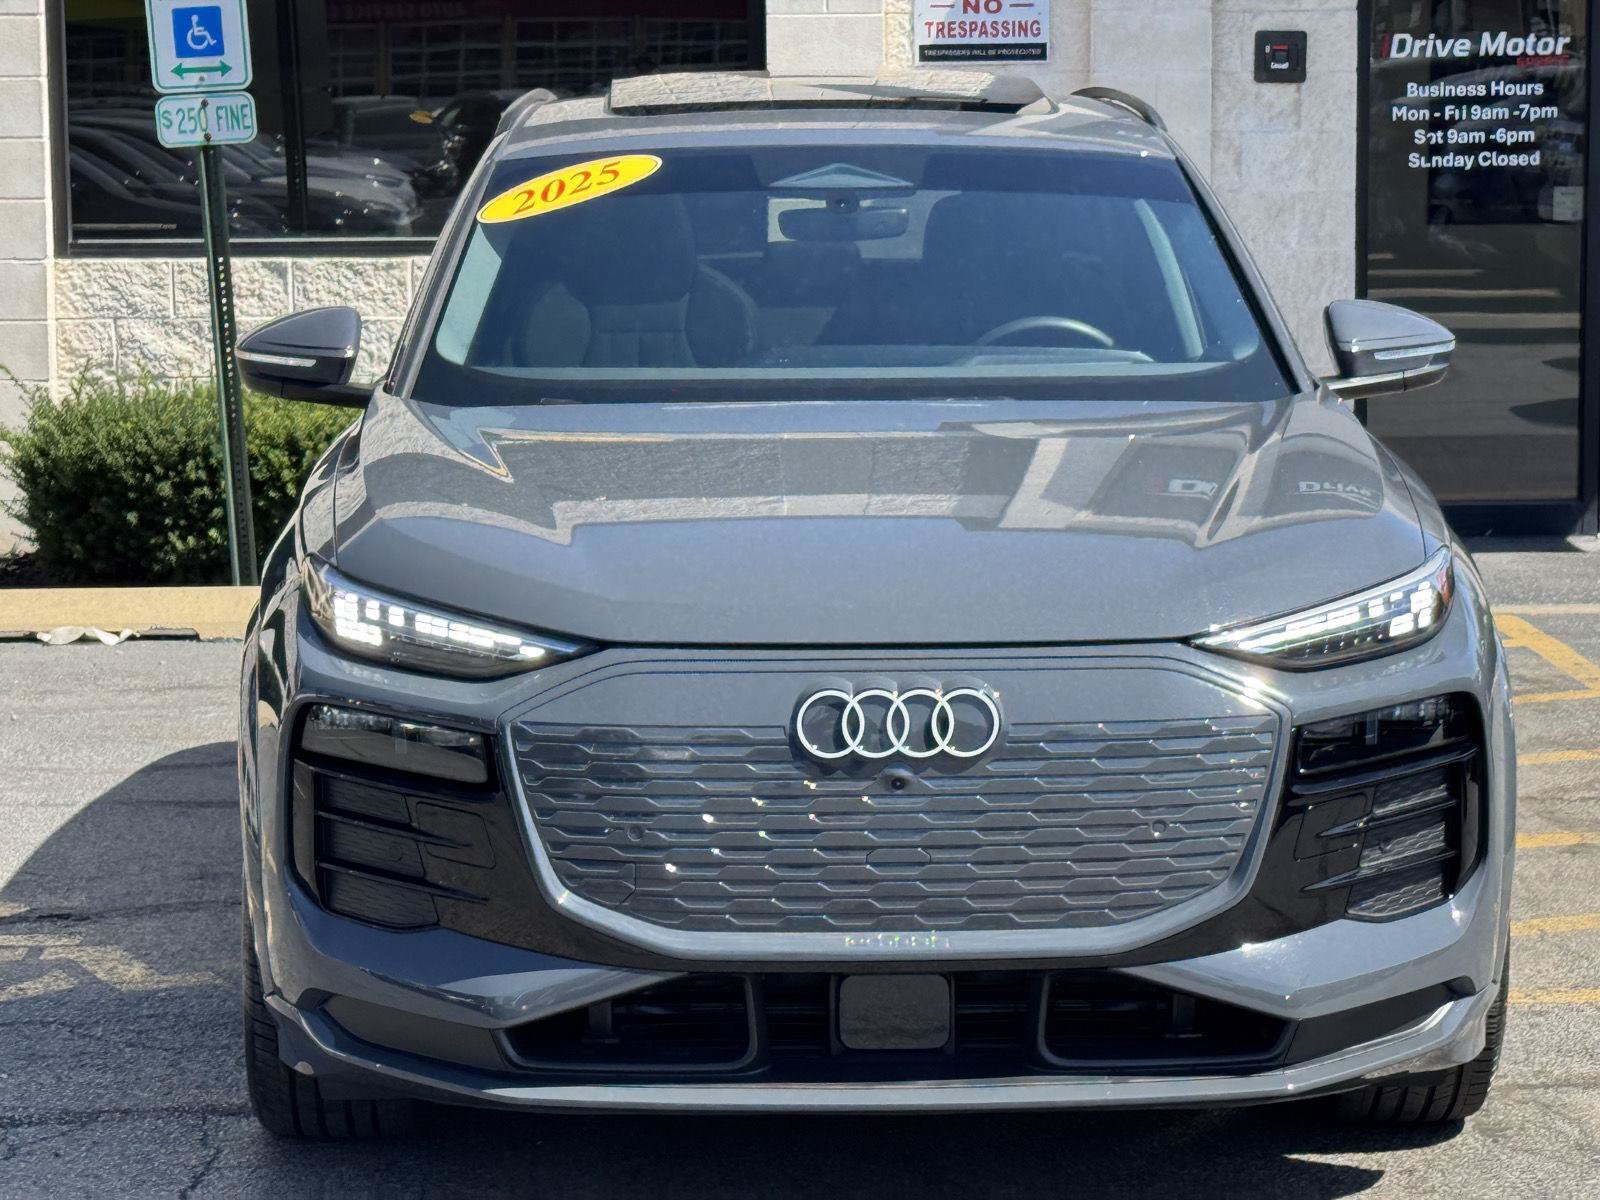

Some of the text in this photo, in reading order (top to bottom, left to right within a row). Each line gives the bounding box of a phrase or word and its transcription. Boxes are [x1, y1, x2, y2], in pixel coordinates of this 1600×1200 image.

[963, 0, 1003, 14] NO
[924, 19, 1041, 39] TRESPASSING
[1479, 31, 1571, 57] Motor
[1406, 81, 1545, 98] Business Hours
[215, 104, 252, 132] FINE
[1392, 105, 1430, 122] Mon
[1470, 104, 1509, 120] 9am
[1447, 128, 1486, 144] 9am
[1408, 150, 1541, 171] Sunday Closed
[512, 160, 621, 216] 2025
